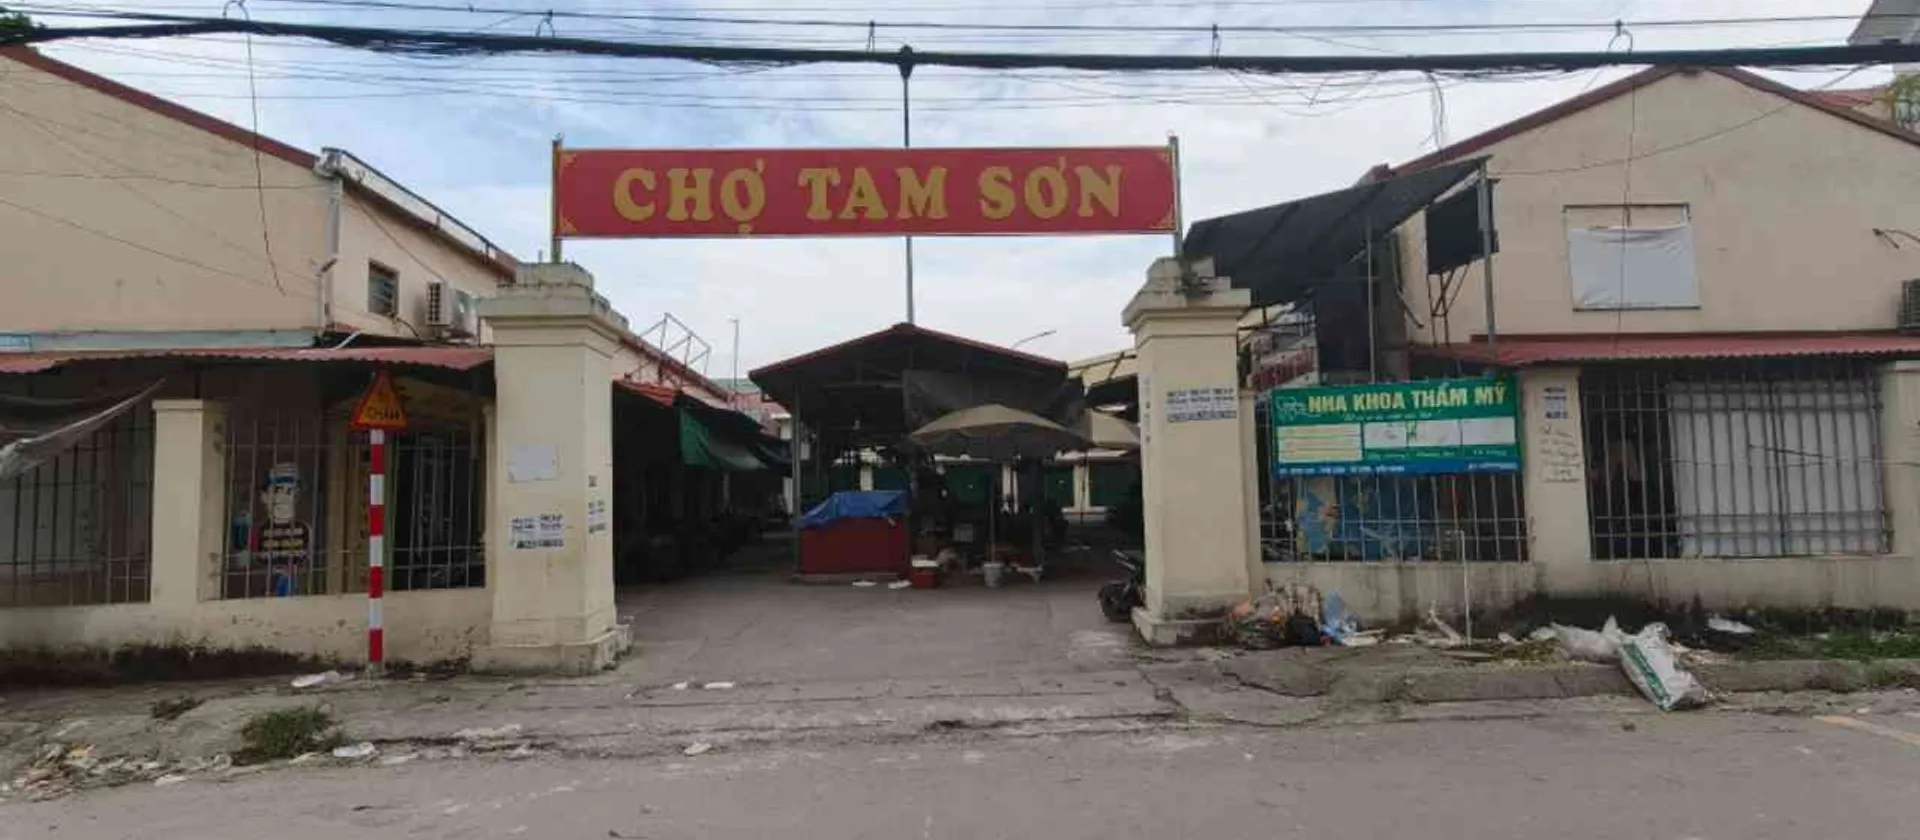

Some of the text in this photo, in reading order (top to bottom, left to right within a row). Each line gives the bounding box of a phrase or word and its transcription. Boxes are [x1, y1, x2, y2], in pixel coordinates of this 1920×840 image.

[614, 156, 1122, 235] CHỢ TAM SƠN
[1308, 394, 1348, 413] NHA
[1353, 390, 1406, 412] KHOA
